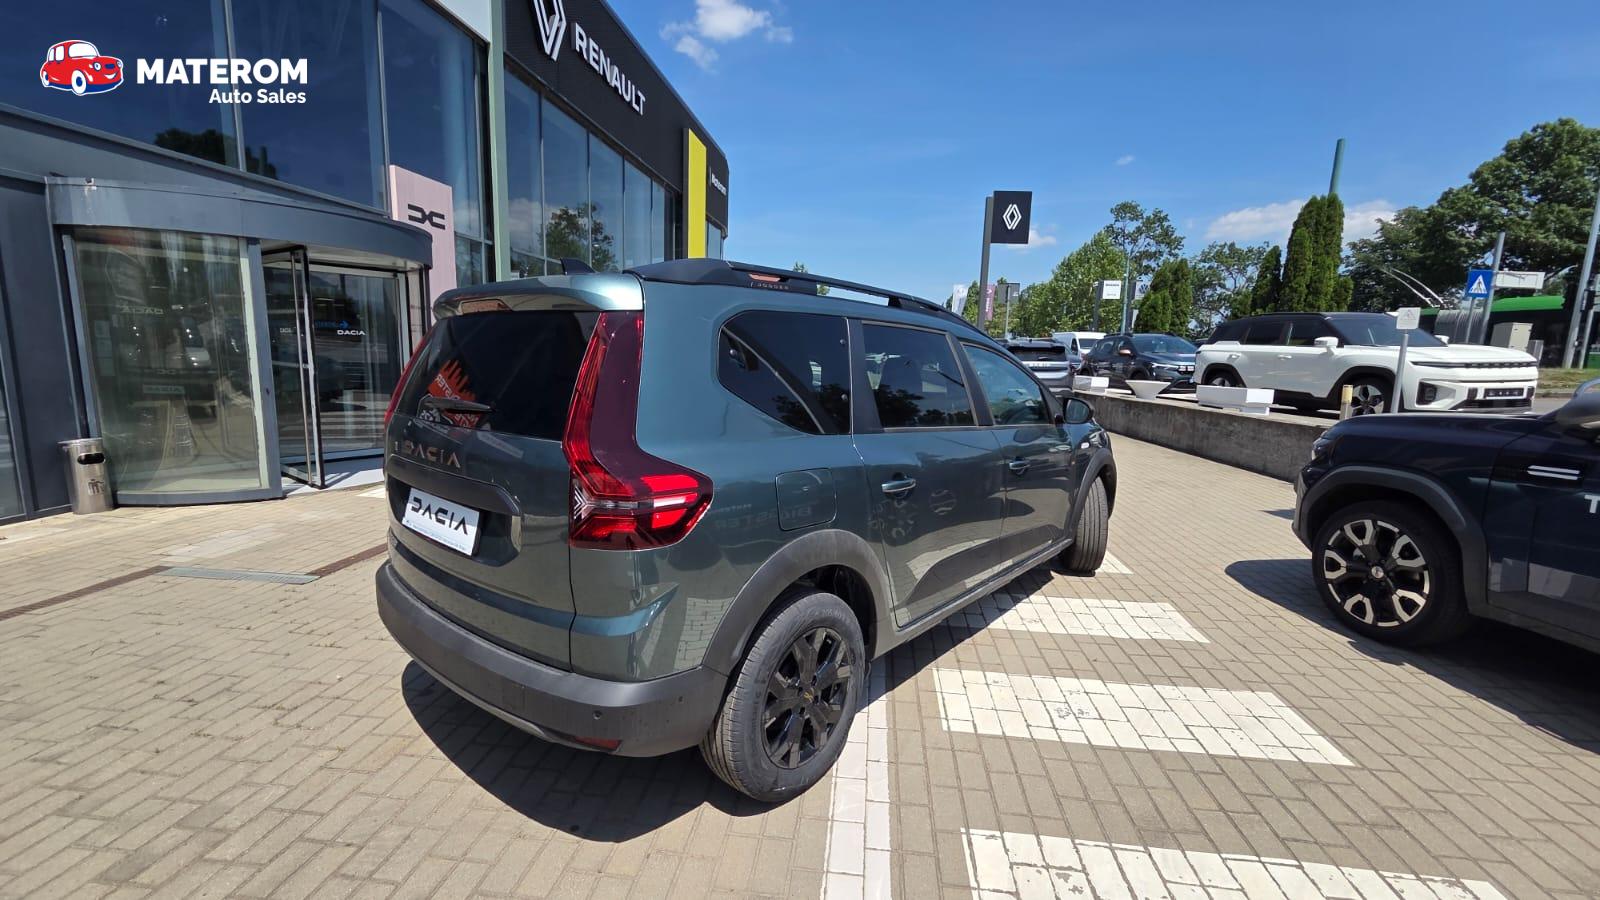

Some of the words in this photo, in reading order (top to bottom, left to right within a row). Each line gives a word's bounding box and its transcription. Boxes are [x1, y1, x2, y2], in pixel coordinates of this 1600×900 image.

[574, 22, 646, 115] RENAULT
[403, 440, 461, 469] DACIA
[411, 496, 469, 536] DACIA
